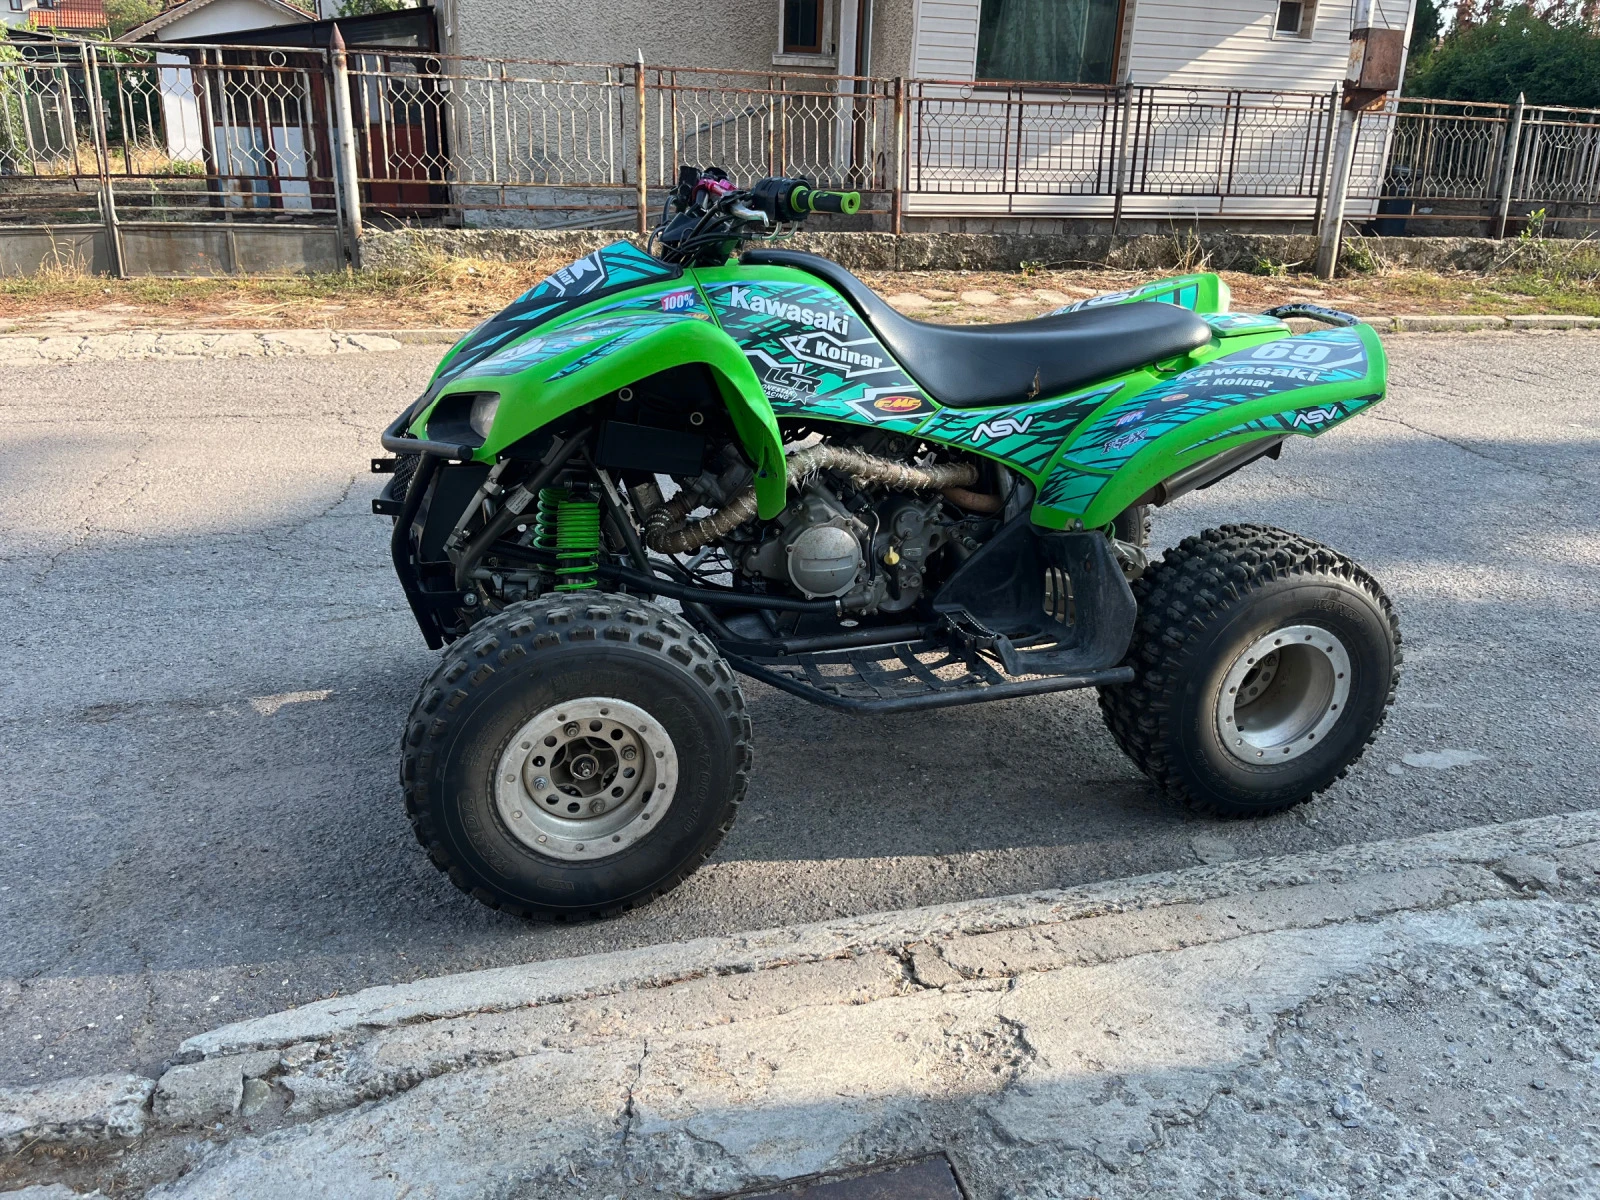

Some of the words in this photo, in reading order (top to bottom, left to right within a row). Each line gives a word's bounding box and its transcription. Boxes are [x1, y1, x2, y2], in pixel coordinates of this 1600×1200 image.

[664, 293, 694, 311] 100%
[730, 286, 849, 336] Kawasaki
[1251, 342, 1332, 363] 69
[764, 367, 823, 396] LSR
[1176, 366, 1321, 382] Kawasaki
[761, 383, 795, 396] ONESTAR
[1293, 406, 1338, 428] ASV
[971, 415, 1033, 442] ASV
